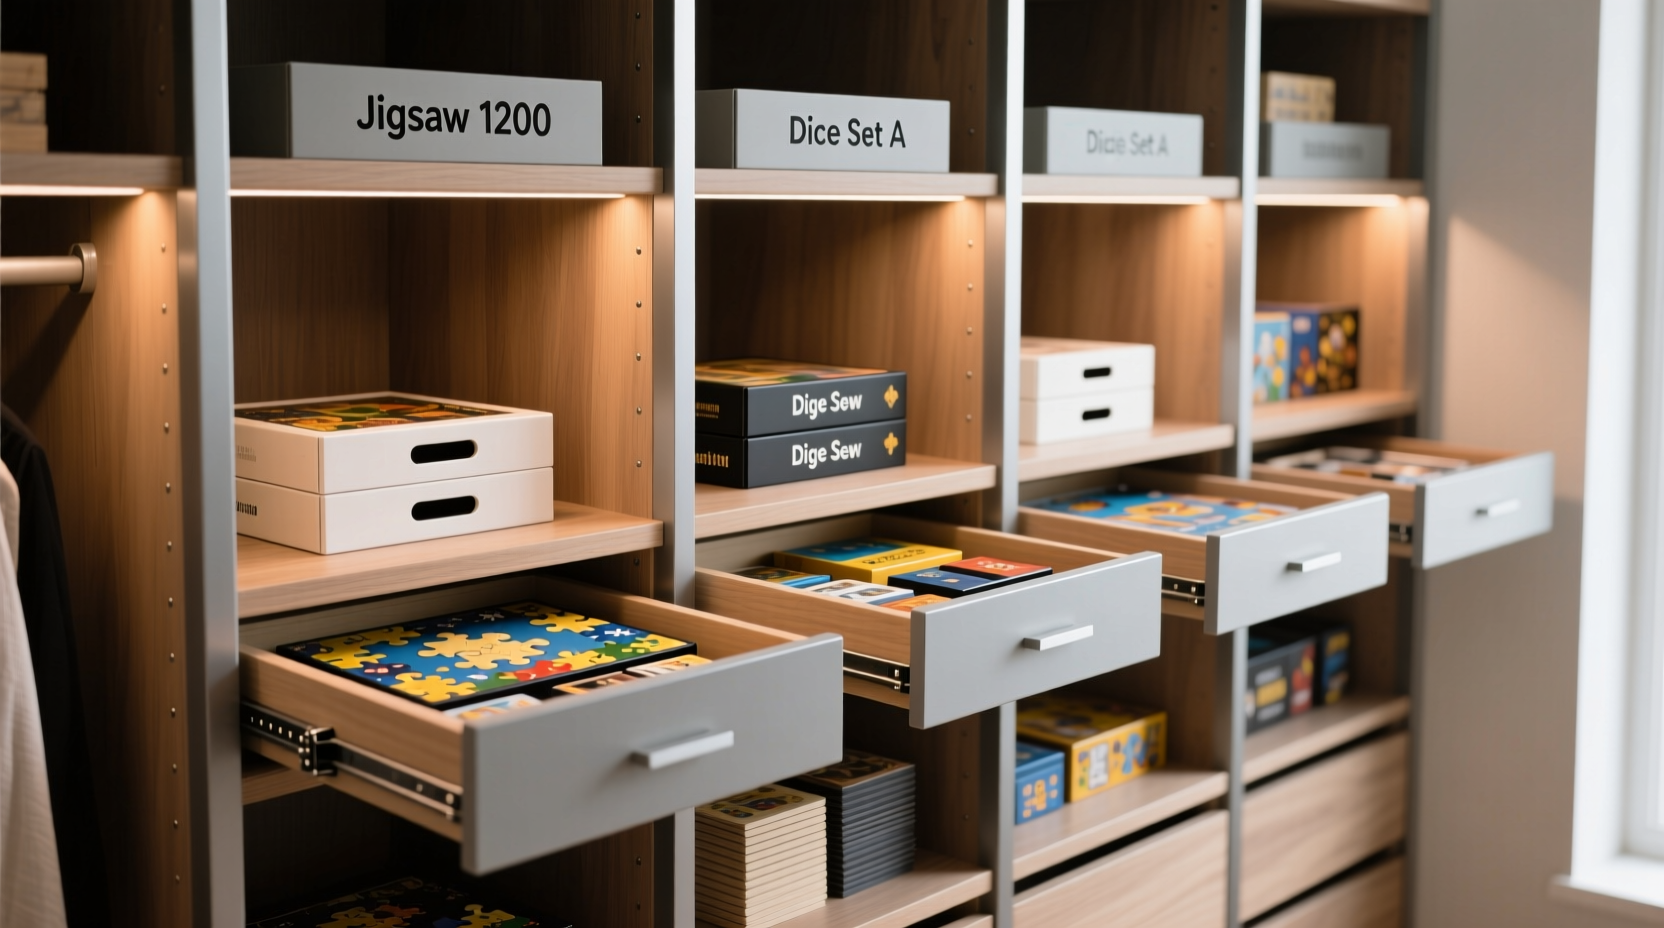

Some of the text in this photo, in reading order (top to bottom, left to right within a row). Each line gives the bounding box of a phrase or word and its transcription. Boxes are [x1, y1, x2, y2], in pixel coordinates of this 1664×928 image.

[357, 94, 551, 140] Jigsaw 1200
[790, 115, 906, 148] Dice Set A
[792, 391, 863, 420] Dige Sew
[791, 440, 863, 470] Dige Sew
